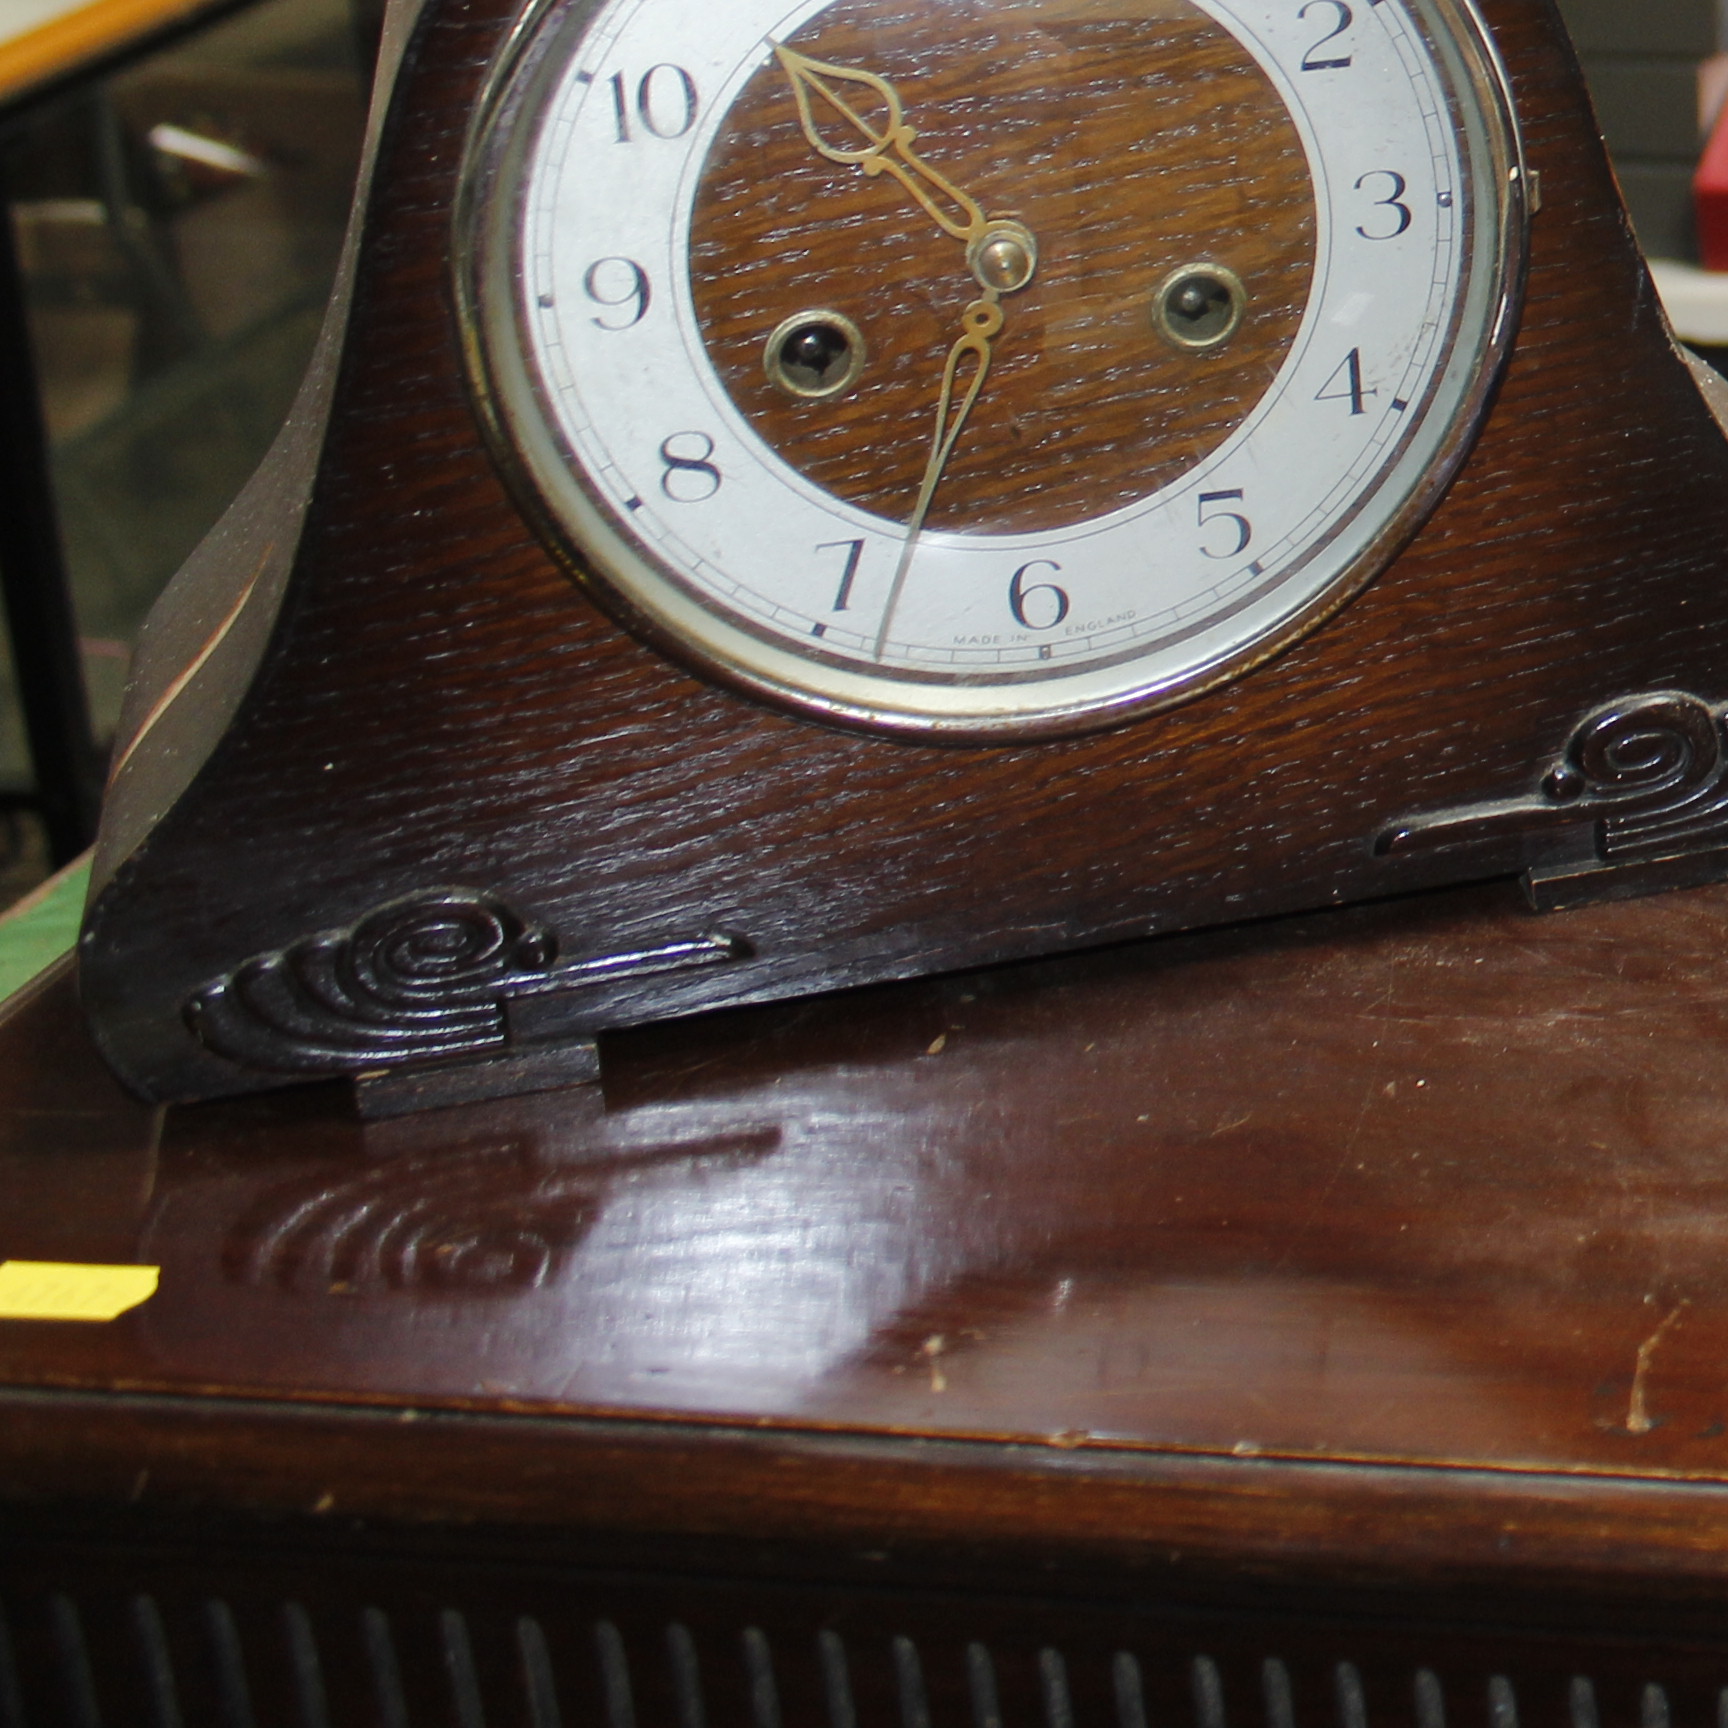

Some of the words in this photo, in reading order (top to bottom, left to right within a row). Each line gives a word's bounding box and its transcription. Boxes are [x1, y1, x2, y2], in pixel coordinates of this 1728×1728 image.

[1295, 0, 1354, 72] 2
[606, 63, 698, 144] 10
[1353, 169, 1413, 241] 3
[583, 255, 650, 331] 9
[1314, 347, 1379, 416] 4
[659, 430, 723, 504] 8
[1198, 487, 1252, 560] 5
[814, 538, 866, 612] 7
[1008, 558, 1072, 631] 6
[953, 634, 1000, 645] MADE
[1009, 634, 1028, 643] IN
[1064, 609, 1137, 636] ENGLAND
